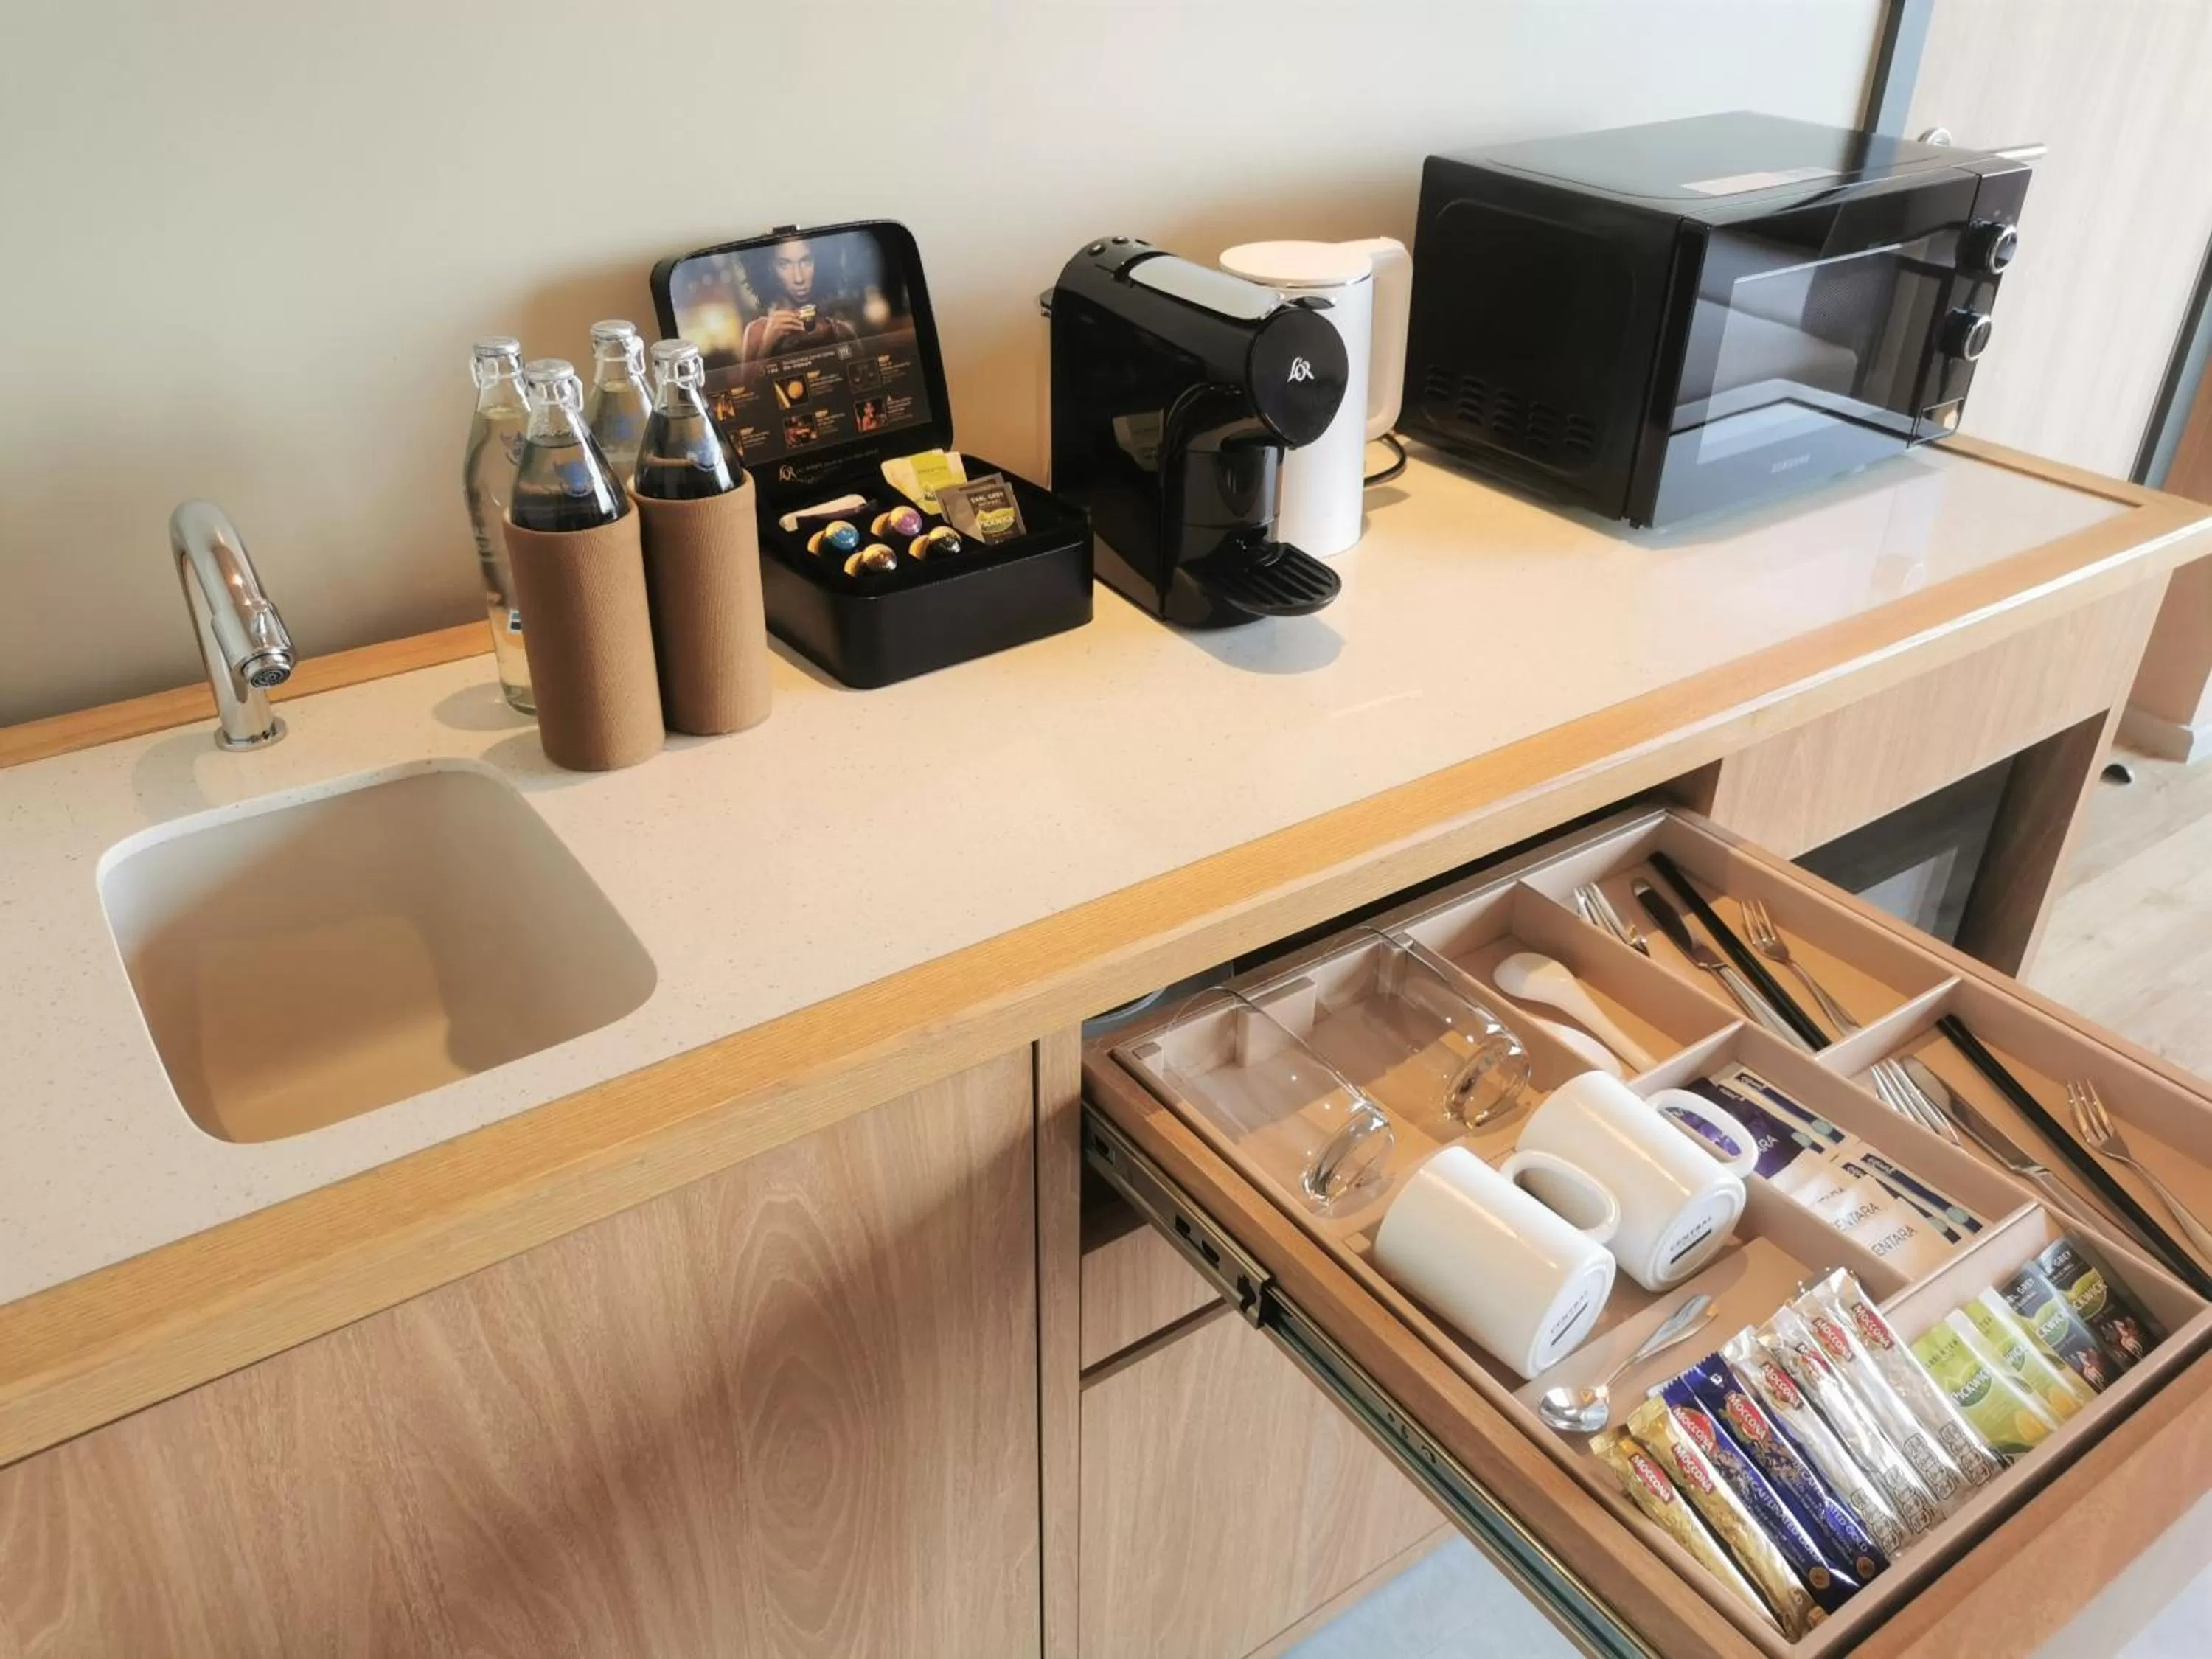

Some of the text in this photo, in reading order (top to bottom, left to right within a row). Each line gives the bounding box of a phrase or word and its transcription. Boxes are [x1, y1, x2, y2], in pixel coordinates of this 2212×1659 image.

[1834, 1203, 1880, 1231] ENTARA
[1871, 1225, 1918, 1256] ENTARA
[1854, 1303, 1893, 1349] MOCCONA
[1630, 1454, 1672, 1502] MOCCONA
[1673, 1443, 1714, 1493] MOCCONA
